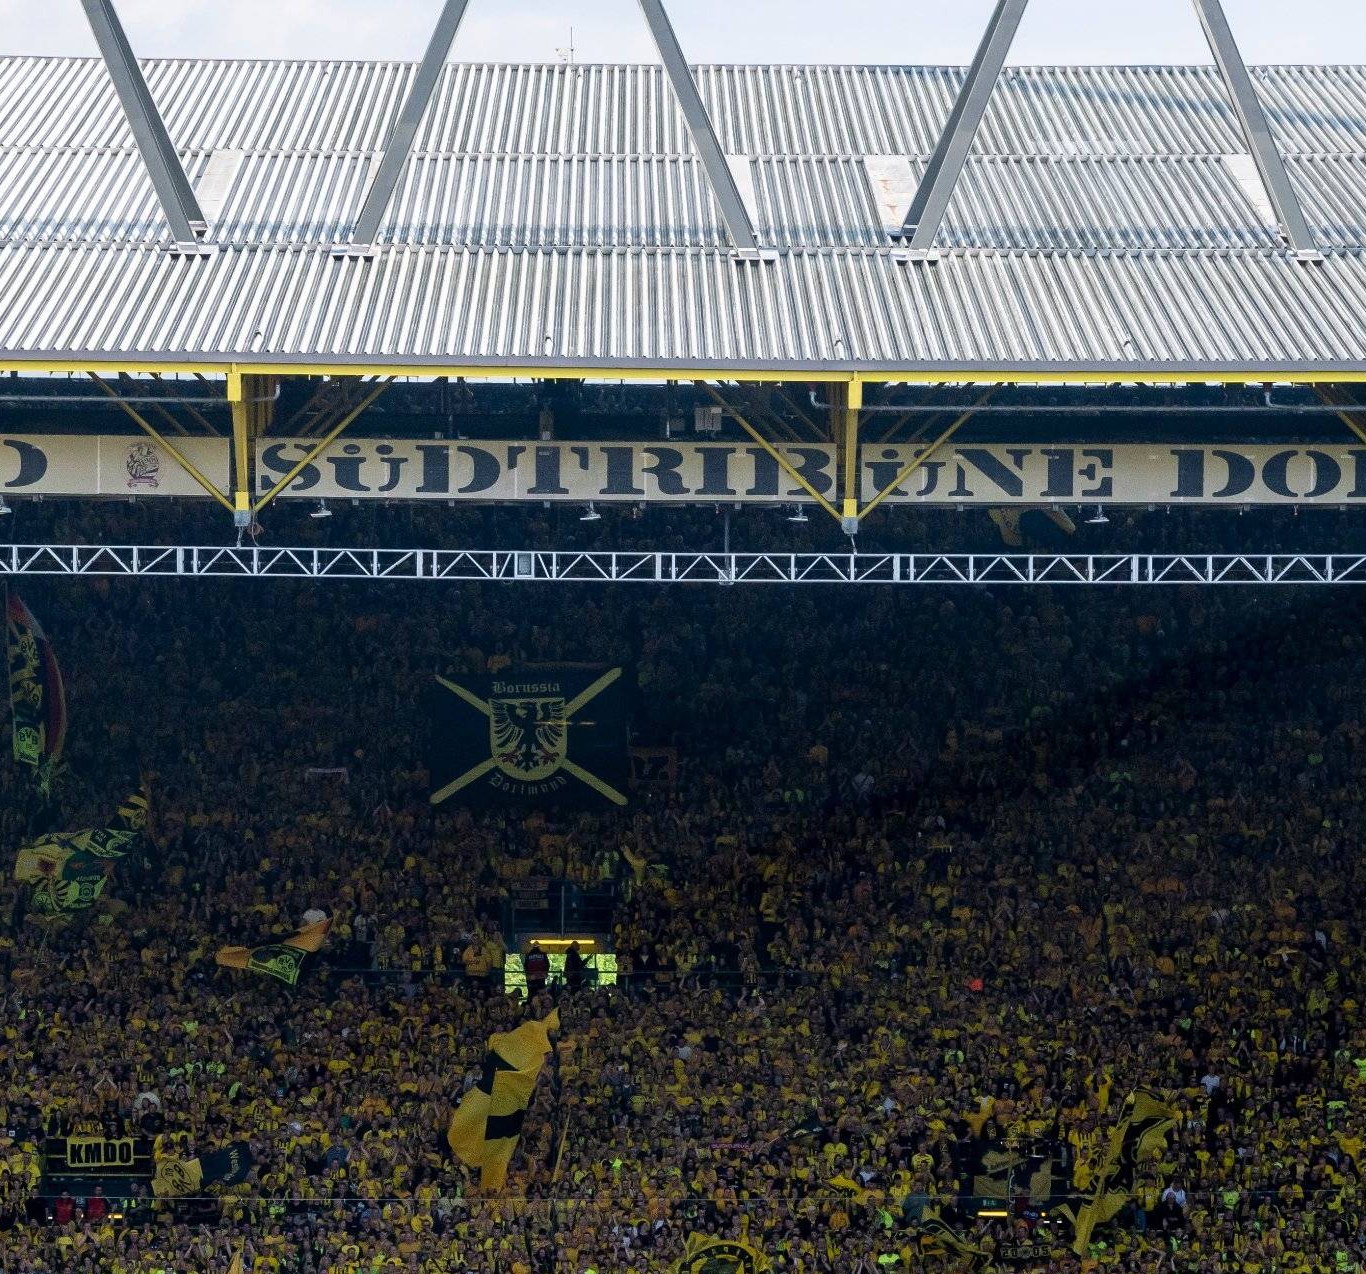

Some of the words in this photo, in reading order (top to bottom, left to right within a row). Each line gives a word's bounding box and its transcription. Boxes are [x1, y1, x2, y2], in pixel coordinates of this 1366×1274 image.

[259, 442, 1113, 498] SÜDTRIBÜNE
[491, 681, 562, 694] Borussia
[69, 1142, 134, 1164] KMDO
